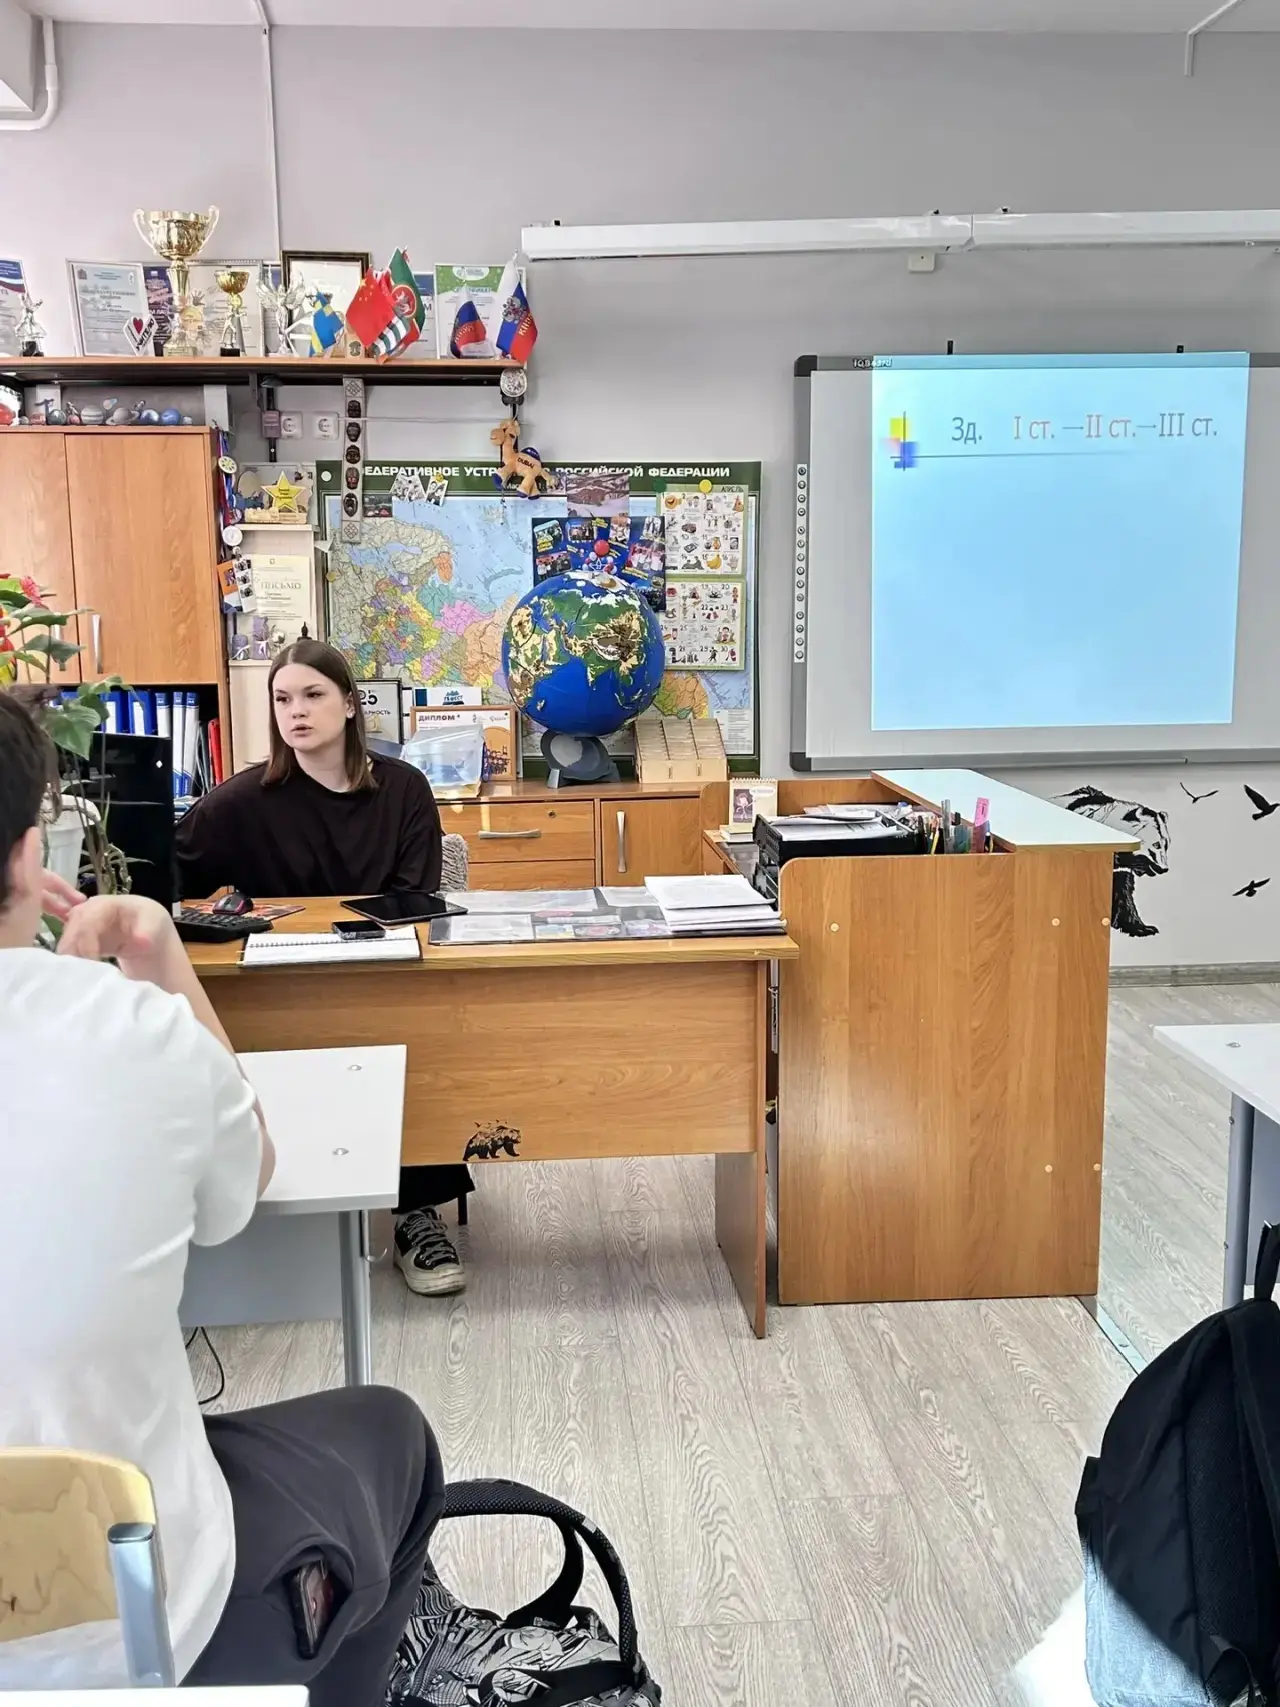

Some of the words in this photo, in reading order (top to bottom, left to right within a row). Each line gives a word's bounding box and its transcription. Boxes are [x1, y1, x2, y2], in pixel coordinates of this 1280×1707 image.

[1029, 421, 1055, 440] ст.
[1109, 419, 1136, 438] ст.
[1191, 418, 1217, 437] ст.
[516, 457, 535, 469] DUBAI
[362, 466, 460, 477] ЕДЕРАТИВНОЕ
[648, 467, 730, 478] ФЕДЕРАЦИИ
[418, 713, 456, 722] ДИПЛОМ
